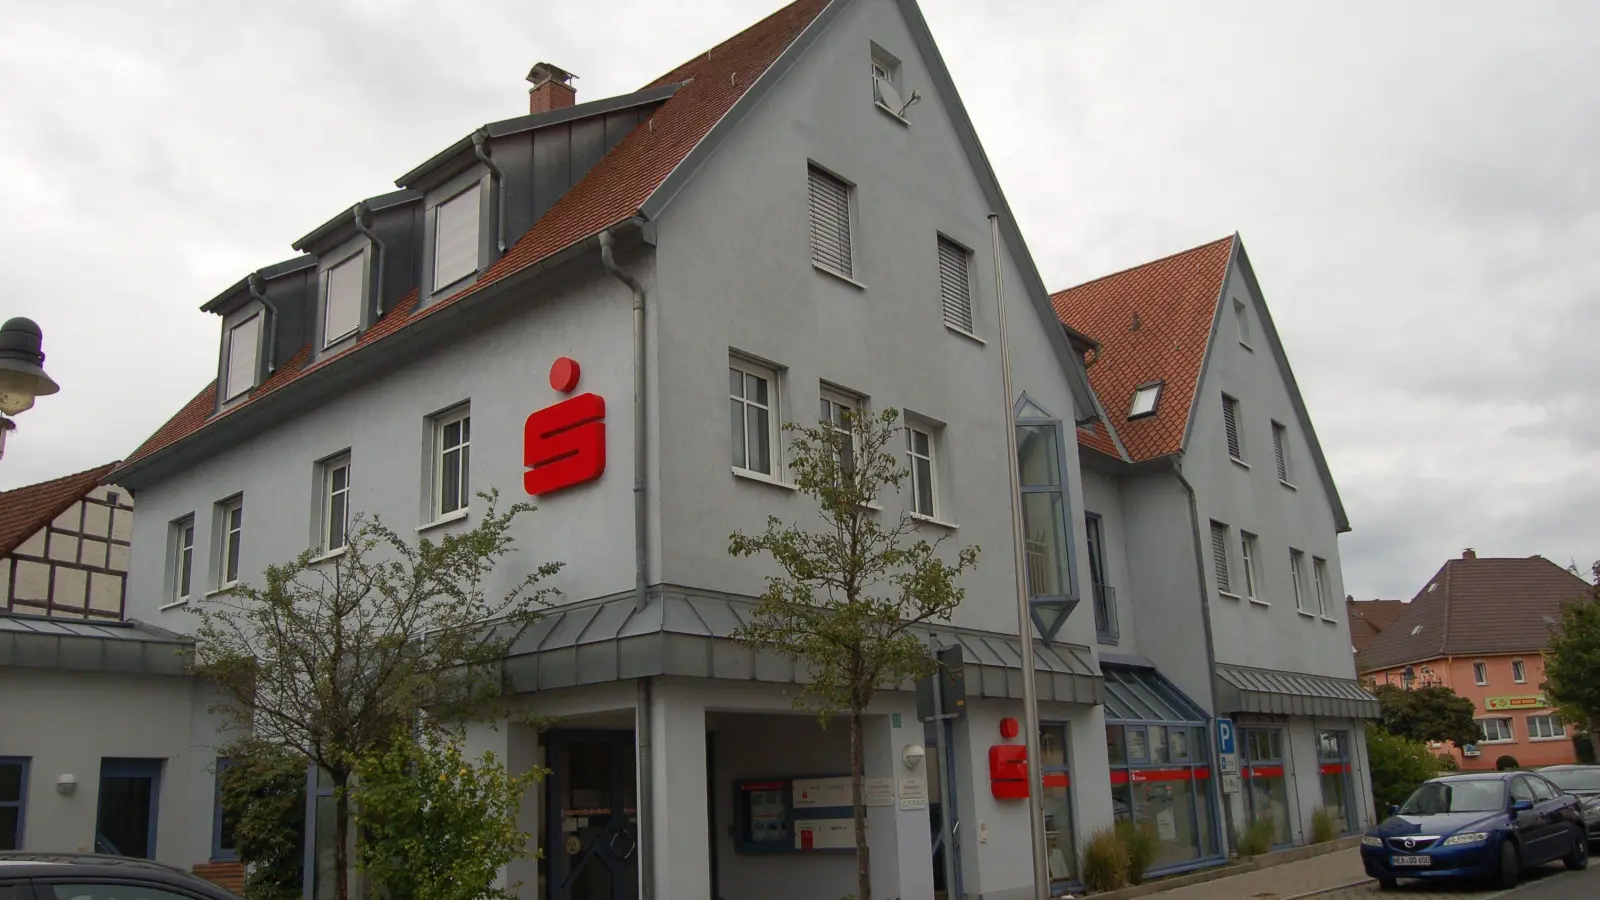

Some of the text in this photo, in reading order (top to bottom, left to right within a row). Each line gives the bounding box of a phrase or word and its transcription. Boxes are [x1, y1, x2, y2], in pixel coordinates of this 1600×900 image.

[1220, 723, 1230, 750] P
[1393, 856, 1405, 865] NEA
[1418, 856, 1430, 865] 600
